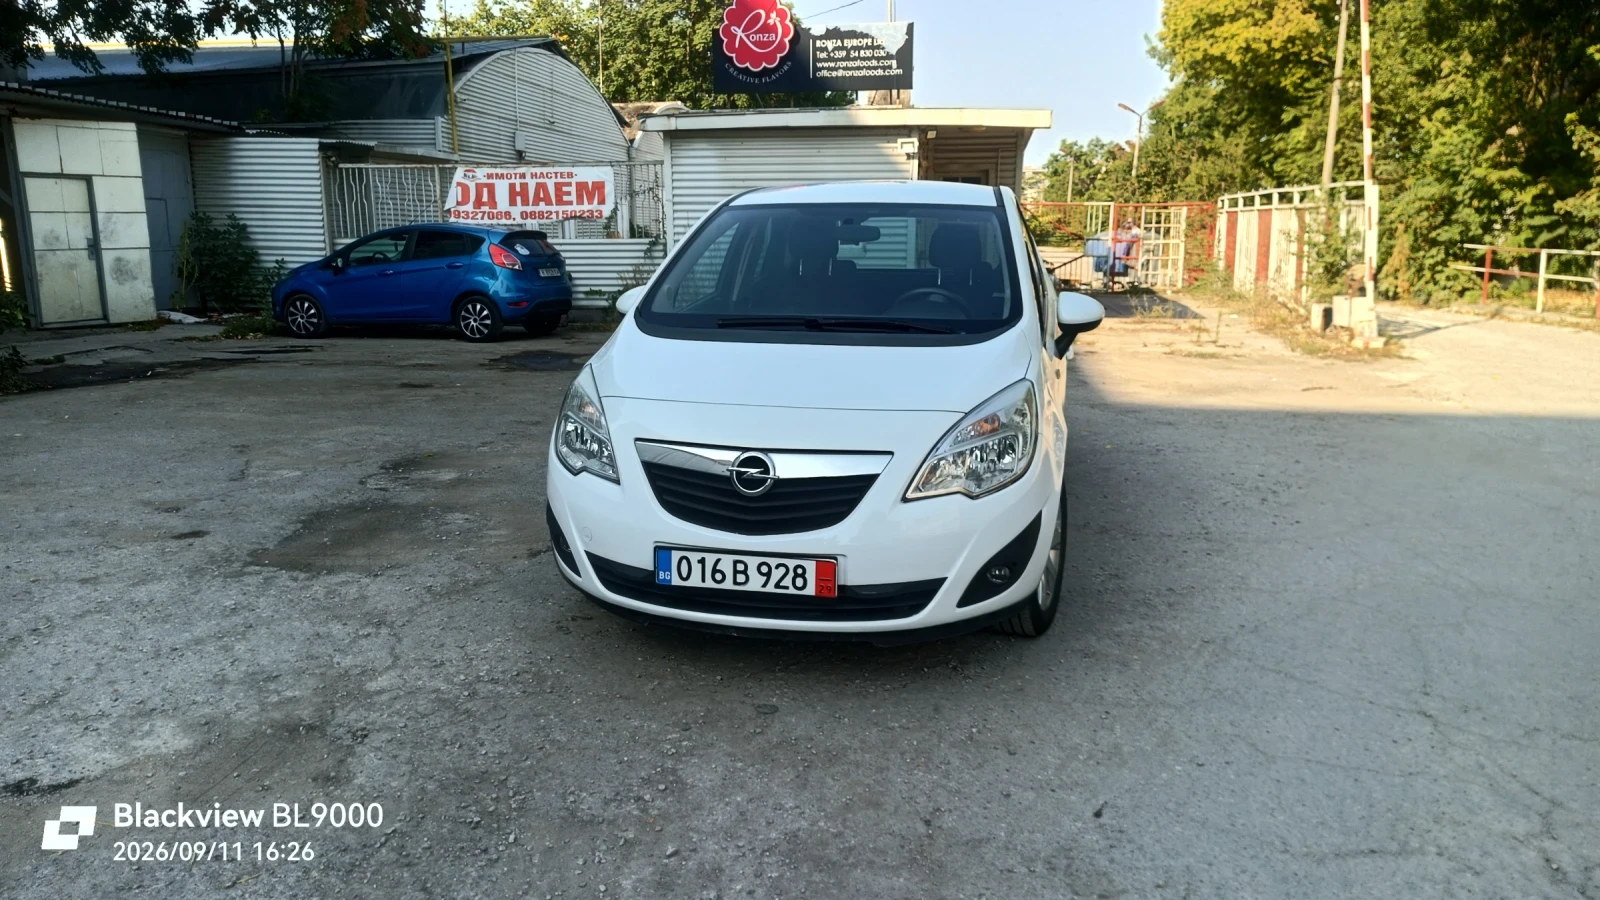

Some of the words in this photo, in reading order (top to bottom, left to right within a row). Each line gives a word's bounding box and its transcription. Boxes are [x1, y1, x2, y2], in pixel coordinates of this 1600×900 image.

[731, 9, 782, 52] Ronza
[816, 39, 842, 48] RONZA
[844, 38, 872, 47] EUROPE
[830, 50, 846, 58] +359
[850, 50, 858, 58] 54
[860, 49, 873, 57] 830
[725, 63, 760, 84] CREATIVE
[762, 61, 792, 83] FLAVORS
[816, 69, 903, 77] office@ronzafoods.com
[508, 181, 606, 207] НАЕМ
[520, 209, 604, 220] 0882150233
[659, 571, 671, 580] BG
[819, 584, 832, 594] 29
